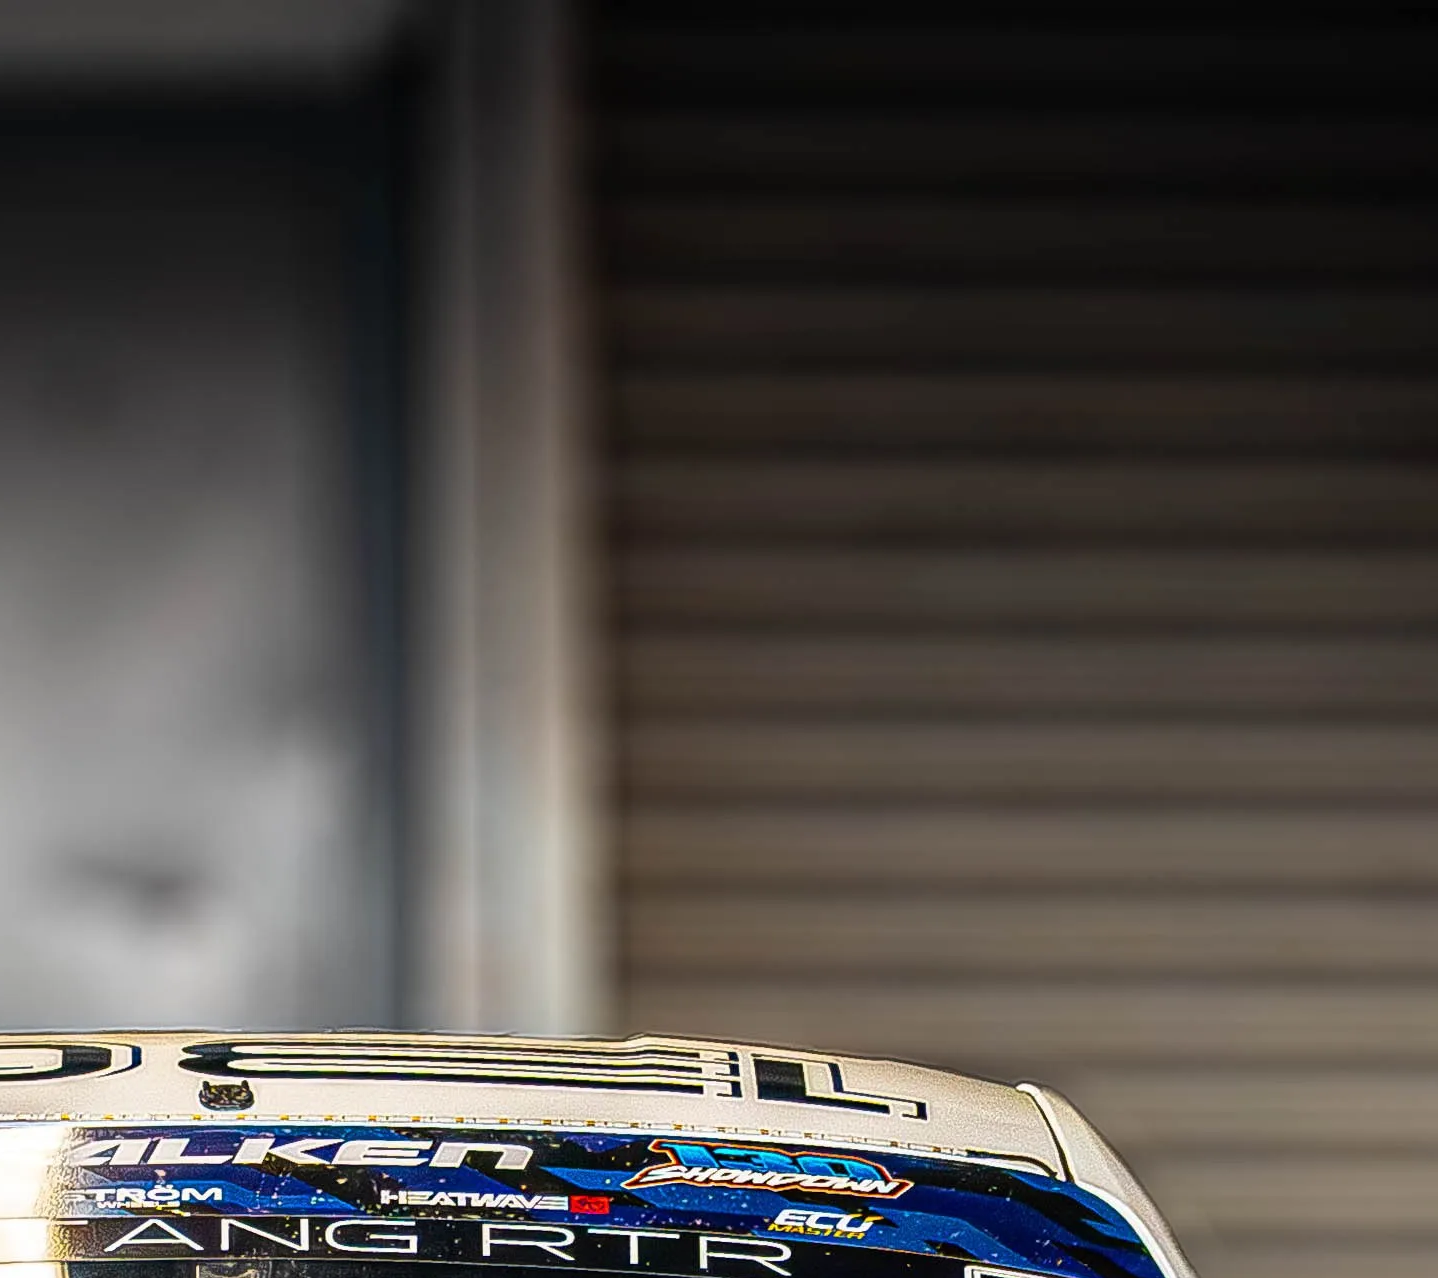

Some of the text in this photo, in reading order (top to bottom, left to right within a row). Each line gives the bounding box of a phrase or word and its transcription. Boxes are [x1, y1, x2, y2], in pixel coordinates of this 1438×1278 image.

[59, 1137, 534, 1167] ALKEN
[658, 1143, 882, 1181] 130
[638, 1166, 894, 1193] SHOWDOWN
[96, 1201, 181, 1209] WHEELS
[379, 1189, 569, 1211] HEATWAVE
[767, 1223, 866, 1240] MASTER
[775, 1208, 884, 1233] ECU
[483, 1226, 792, 1277] RTR
